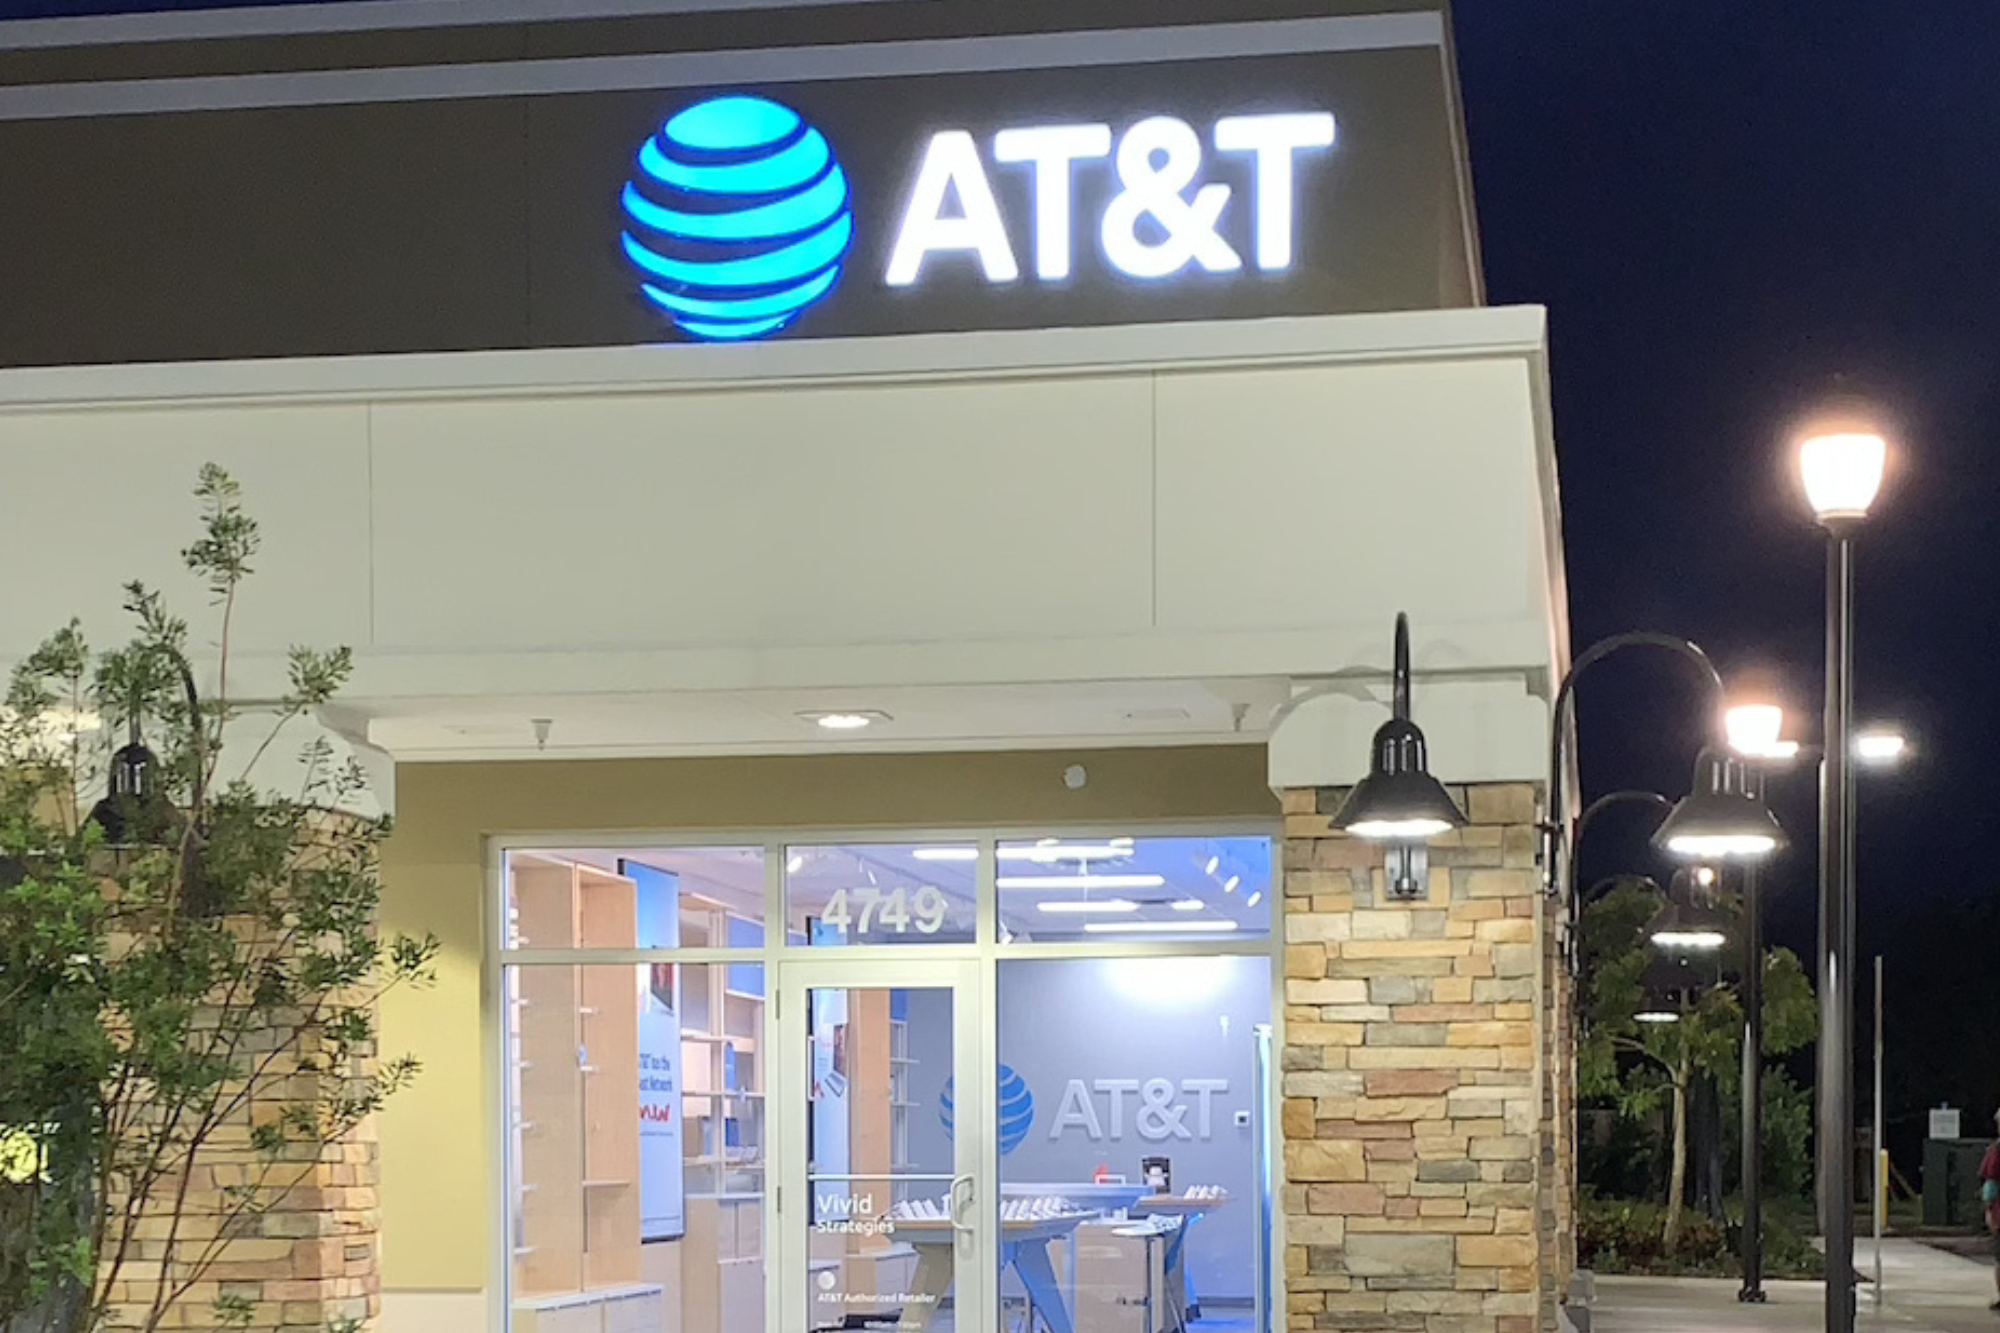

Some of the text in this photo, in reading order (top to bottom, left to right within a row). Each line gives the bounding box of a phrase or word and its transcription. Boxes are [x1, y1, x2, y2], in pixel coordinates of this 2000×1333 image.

[885, 112, 1336, 287] AT&T
[821, 886, 946, 933] 4749
[1048, 1077, 1230, 1140] AT&T
[817, 1193, 872, 1213] Vivid
[817, 1219, 895, 1237] Strategies
[817, 1292, 843, 1303] AT&T
[898, 1292, 936, 1303] Retailer
